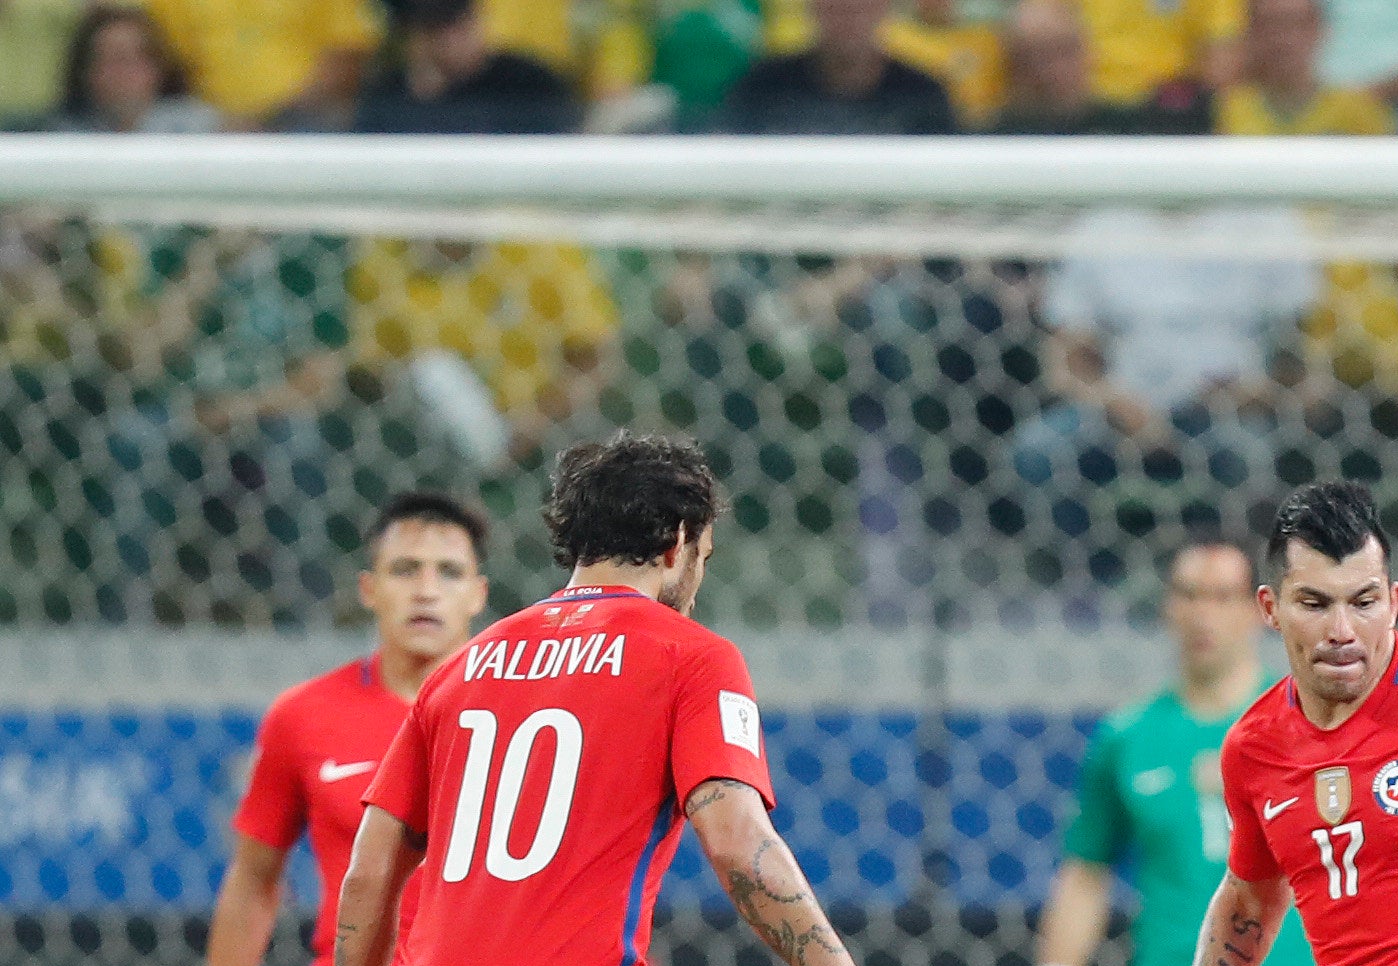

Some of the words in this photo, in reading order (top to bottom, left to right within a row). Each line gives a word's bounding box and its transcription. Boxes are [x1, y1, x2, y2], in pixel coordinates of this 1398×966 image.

[563, 589, 575, 597] LA
[577, 587, 603, 595] ROJA
[464, 632, 626, 683] VALDIVIA
[441, 707, 584, 883] 10
[1311, 820, 1366, 900] 17
